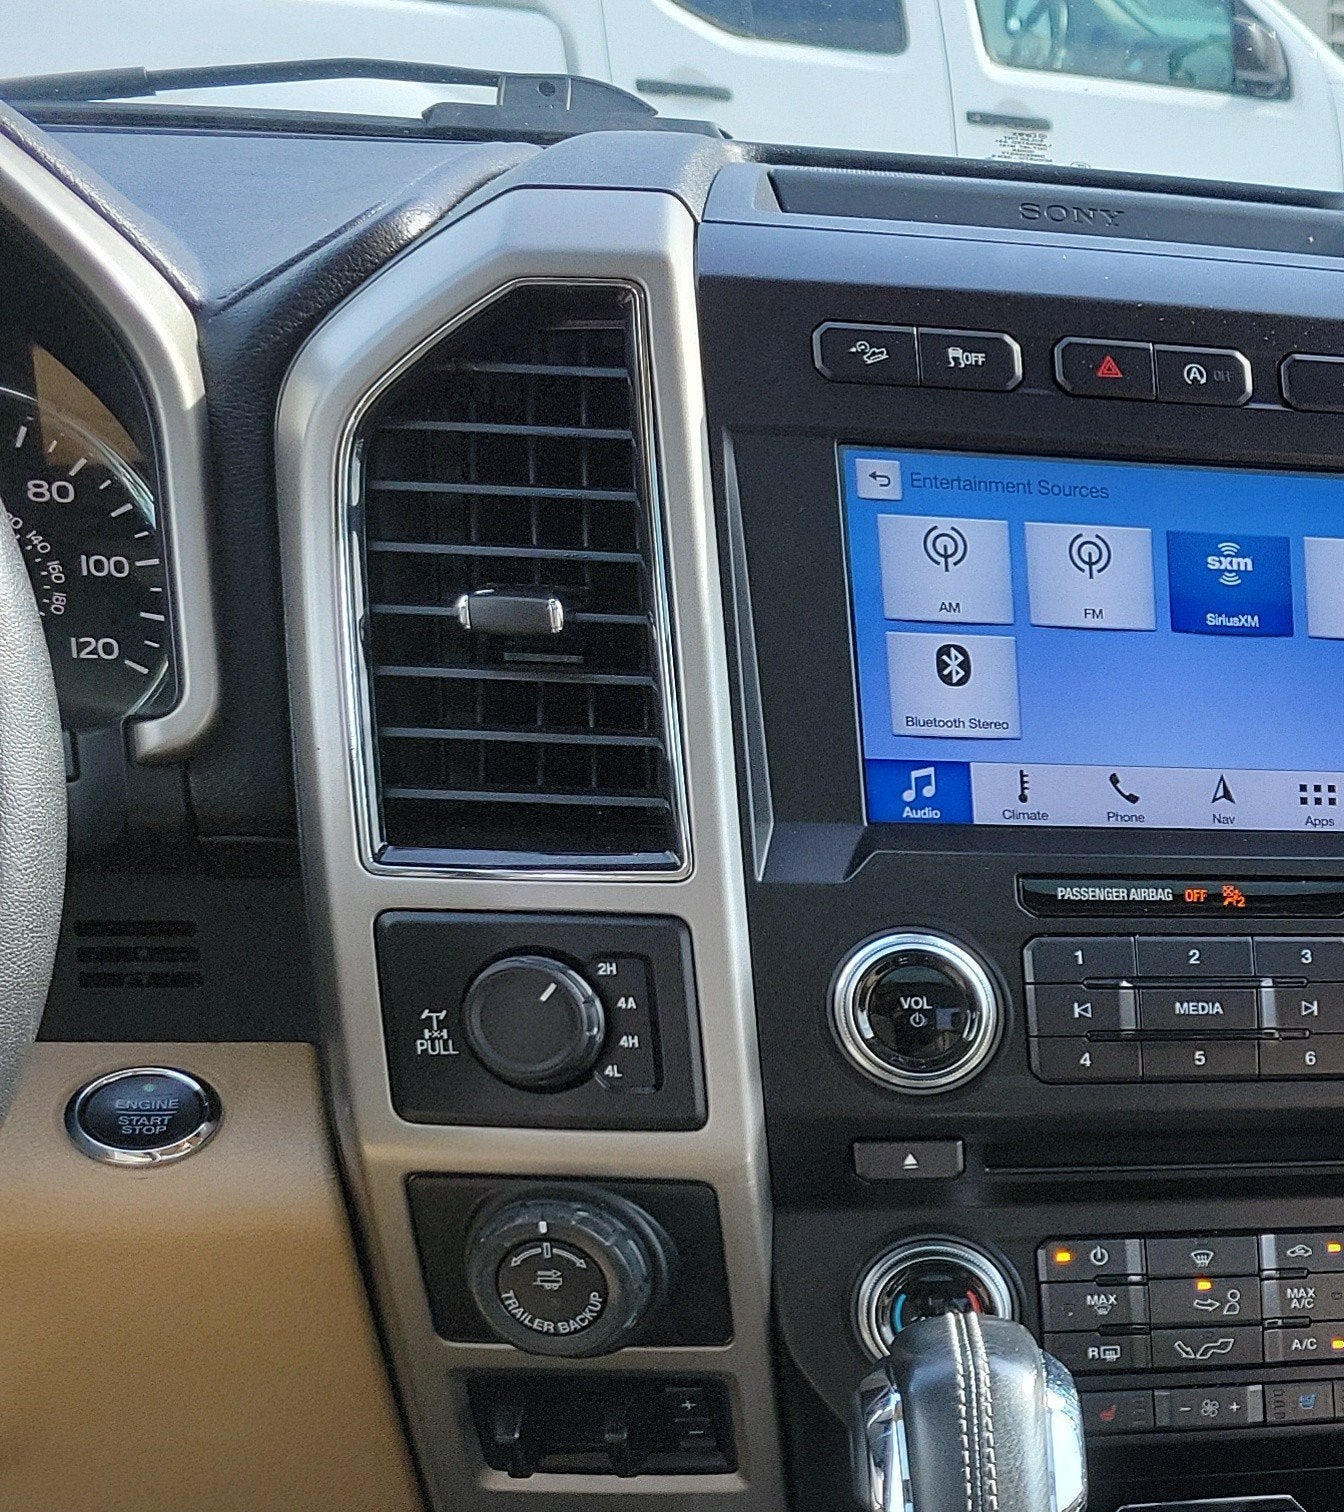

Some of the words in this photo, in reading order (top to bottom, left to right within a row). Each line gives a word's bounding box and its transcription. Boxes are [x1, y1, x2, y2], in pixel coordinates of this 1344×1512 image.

[1018, 202, 1125, 227] SONY
[963, 353, 986, 367] OFF
[26, 479, 76, 504] 80
[910, 472, 1033, 496] Entertainment
[1038, 479, 1110, 500] Sources
[25, 530, 51, 554] 140
[80, 554, 130, 578] 100
[1206, 554, 1254, 572] sxm
[46, 560, 66, 584] 160
[50, 591, 68, 616] 180
[938, 602, 961, 614] AM
[1083, 608, 1104, 620] FM
[1205, 613, 1260, 629] SiriusXM
[70, 637, 119, 660] 120
[905, 715, 966, 730] Bluetooth
[968, 718, 1010, 732] Stereo
[902, 805, 942, 820] Audio
[1002, 808, 1049, 822] Climate
[1106, 810, 1146, 824] Phone
[1211, 813, 1236, 826] Nav
[1304, 815, 1336, 830] Apps
[1057, 887, 1128, 901] PASSENGER
[1129, 887, 1174, 901] AIRBAG
[1184, 888, 1208, 903] OFF
[1073, 949, 1085, 965] 1
[1188, 949, 1200, 965] 2
[1301, 949, 1313, 964] 3
[597, 962, 618, 976] 2H
[616, 996, 638, 1010] 4A
[900, 996, 932, 1010] VOL
[1174, 1001, 1224, 1016] MEDIA
[415, 1038, 460, 1056] PULL
[618, 1035, 640, 1049] 4H
[1079, 1052, 1092, 1067] 4
[1194, 1051, 1206, 1066] 5
[1304, 1050, 1316, 1066] 6
[603, 1064, 623, 1078] 4L
[114, 1098, 179, 1110] ENGINE
[117, 1115, 173, 1126] START
[121, 1125, 167, 1135] STOP
[1086, 1293, 1117, 1306] MAX
[1286, 1287, 1316, 1299] MAX
[1291, 1298, 1315, 1310] A/C
[501, 1289, 555, 1333] TRAILER
[557, 1291, 603, 1334] BACKUP
[1292, 1338, 1318, 1351] A/C
[1088, 1346, 1100, 1360] R
